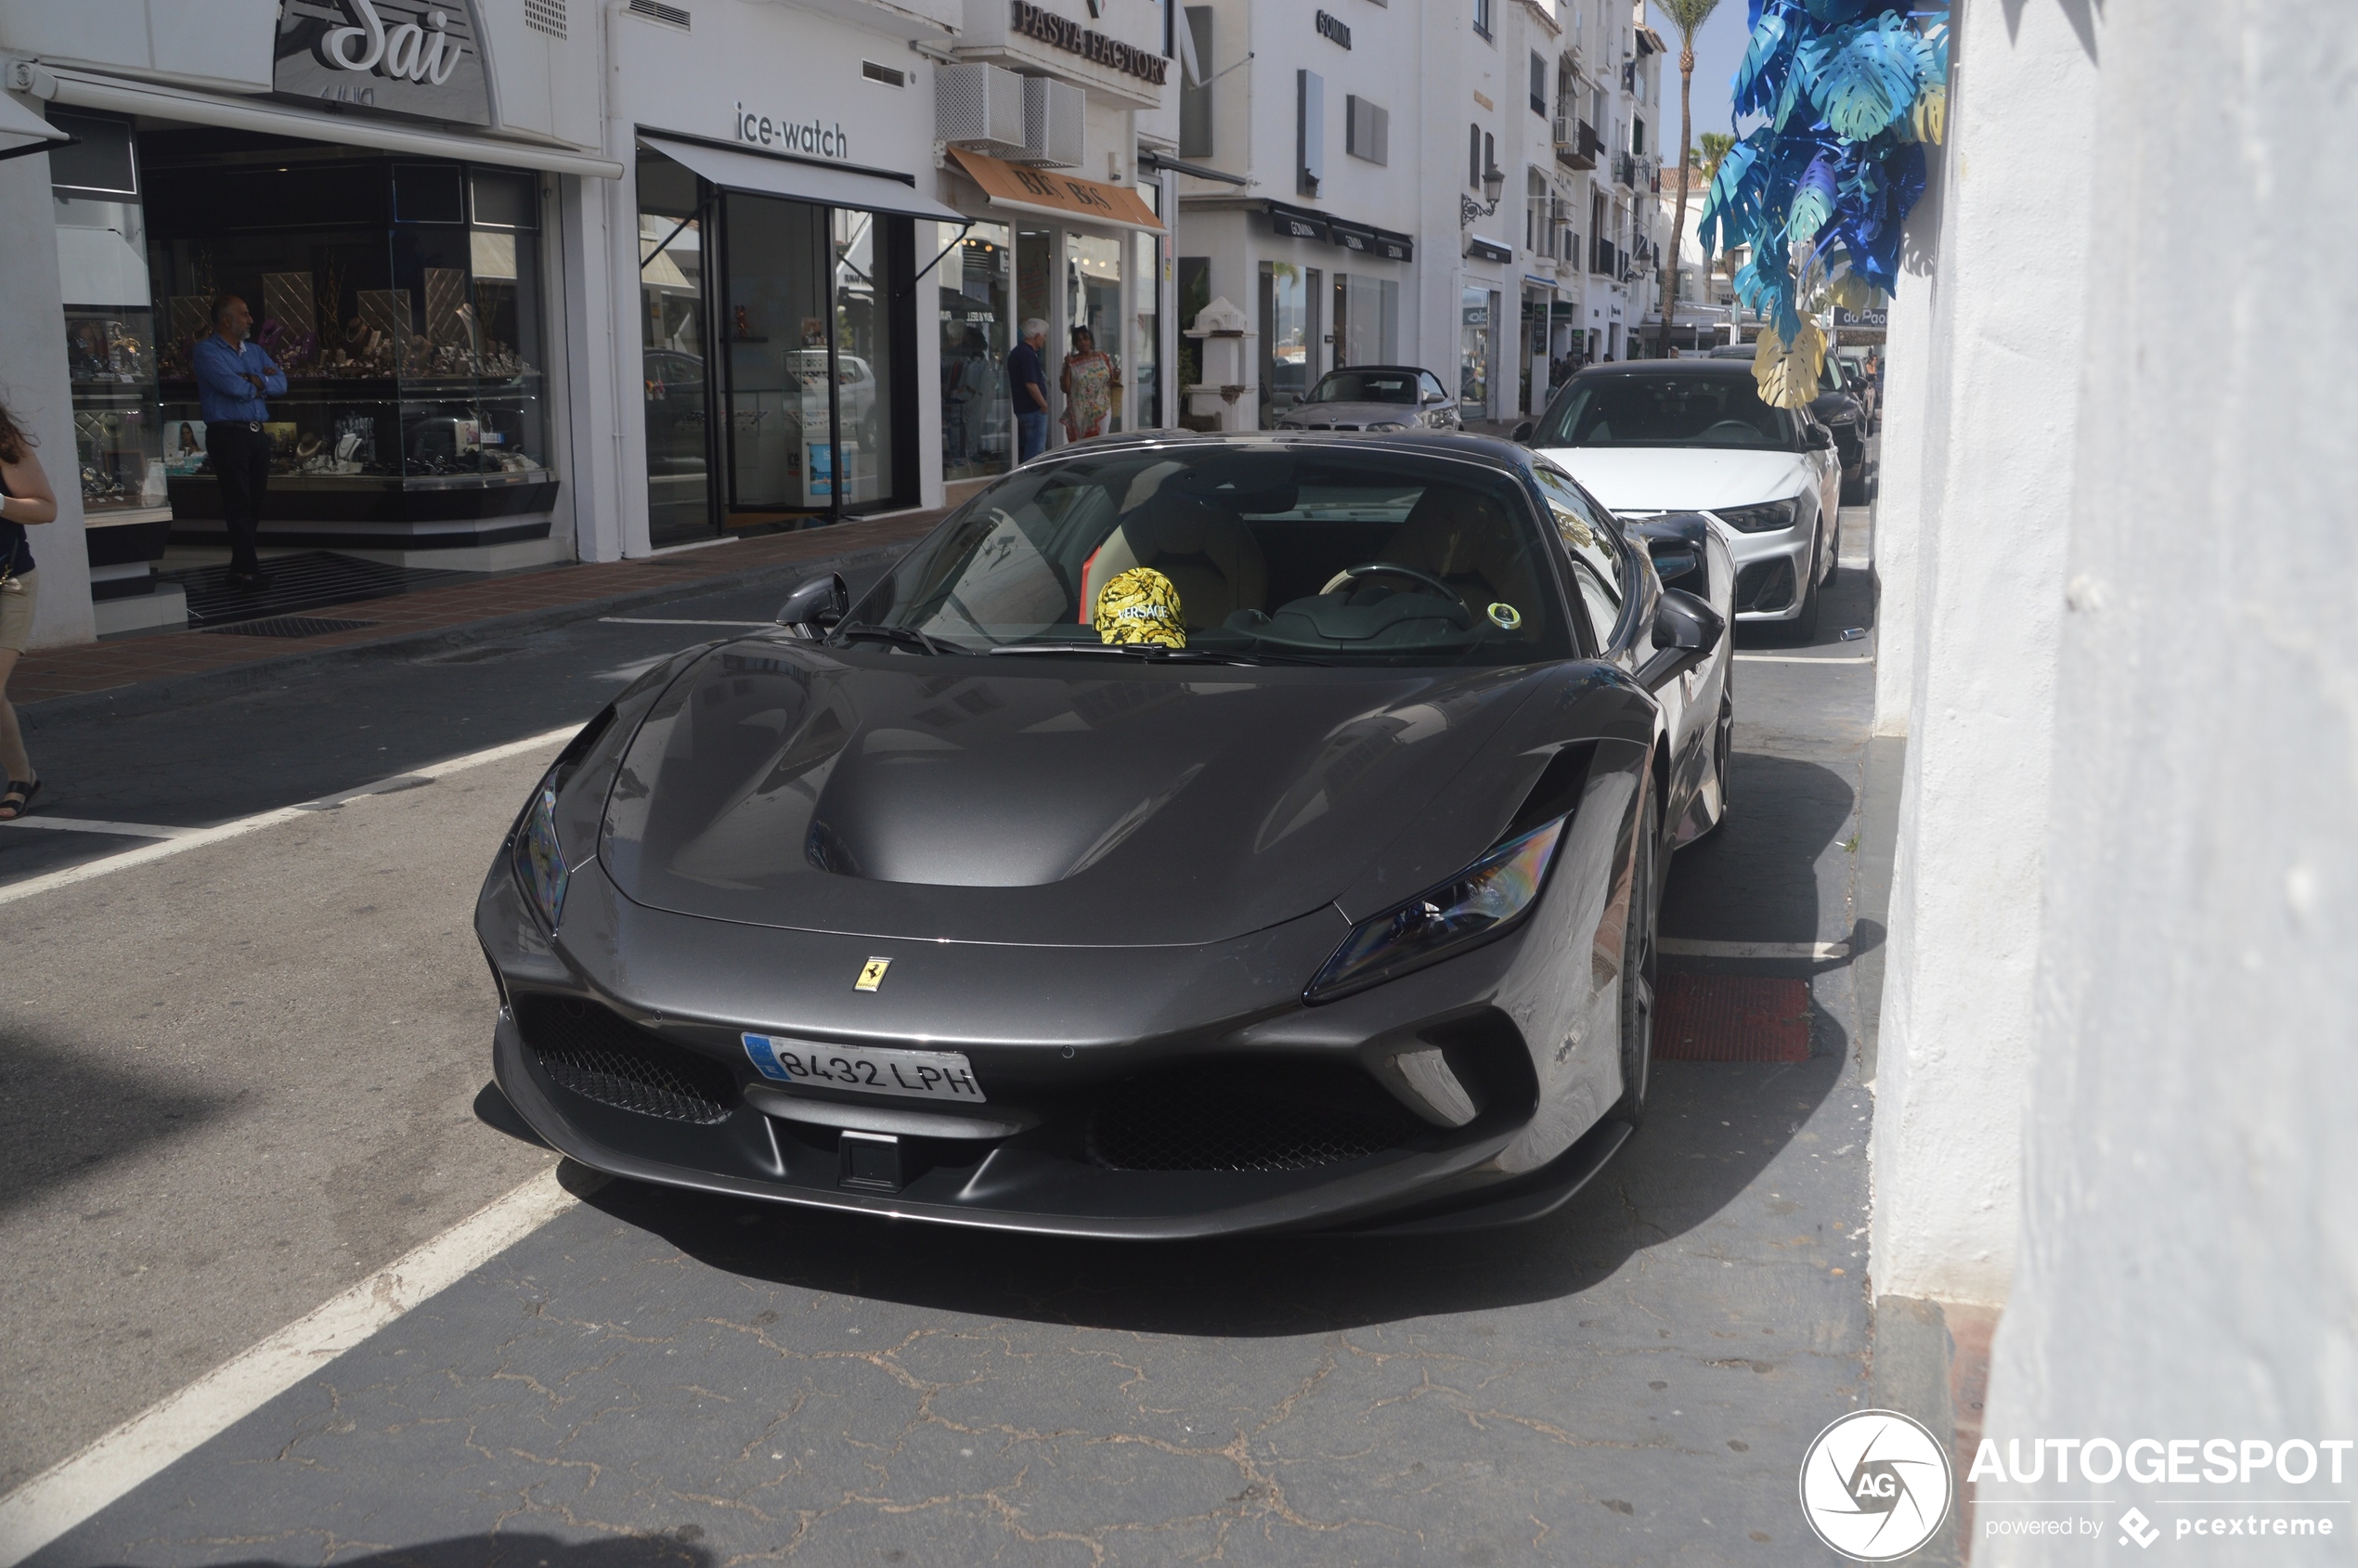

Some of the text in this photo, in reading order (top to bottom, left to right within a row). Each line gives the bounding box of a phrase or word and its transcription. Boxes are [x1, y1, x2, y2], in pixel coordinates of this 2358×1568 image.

[1014, 0, 1170, 84] PASTA FACTORY
[1316, 9, 1352, 50] GOMINA
[736, 100, 847, 159] ice-watch
[1290, 221, 1316, 237] GOMINA
[1345, 235, 1365, 251] GOMINA
[1388, 245, 1403, 258] GOMINA
[1118, 604, 1168, 620] VERSACE
[779, 1052, 977, 1095] 8432 LPH
